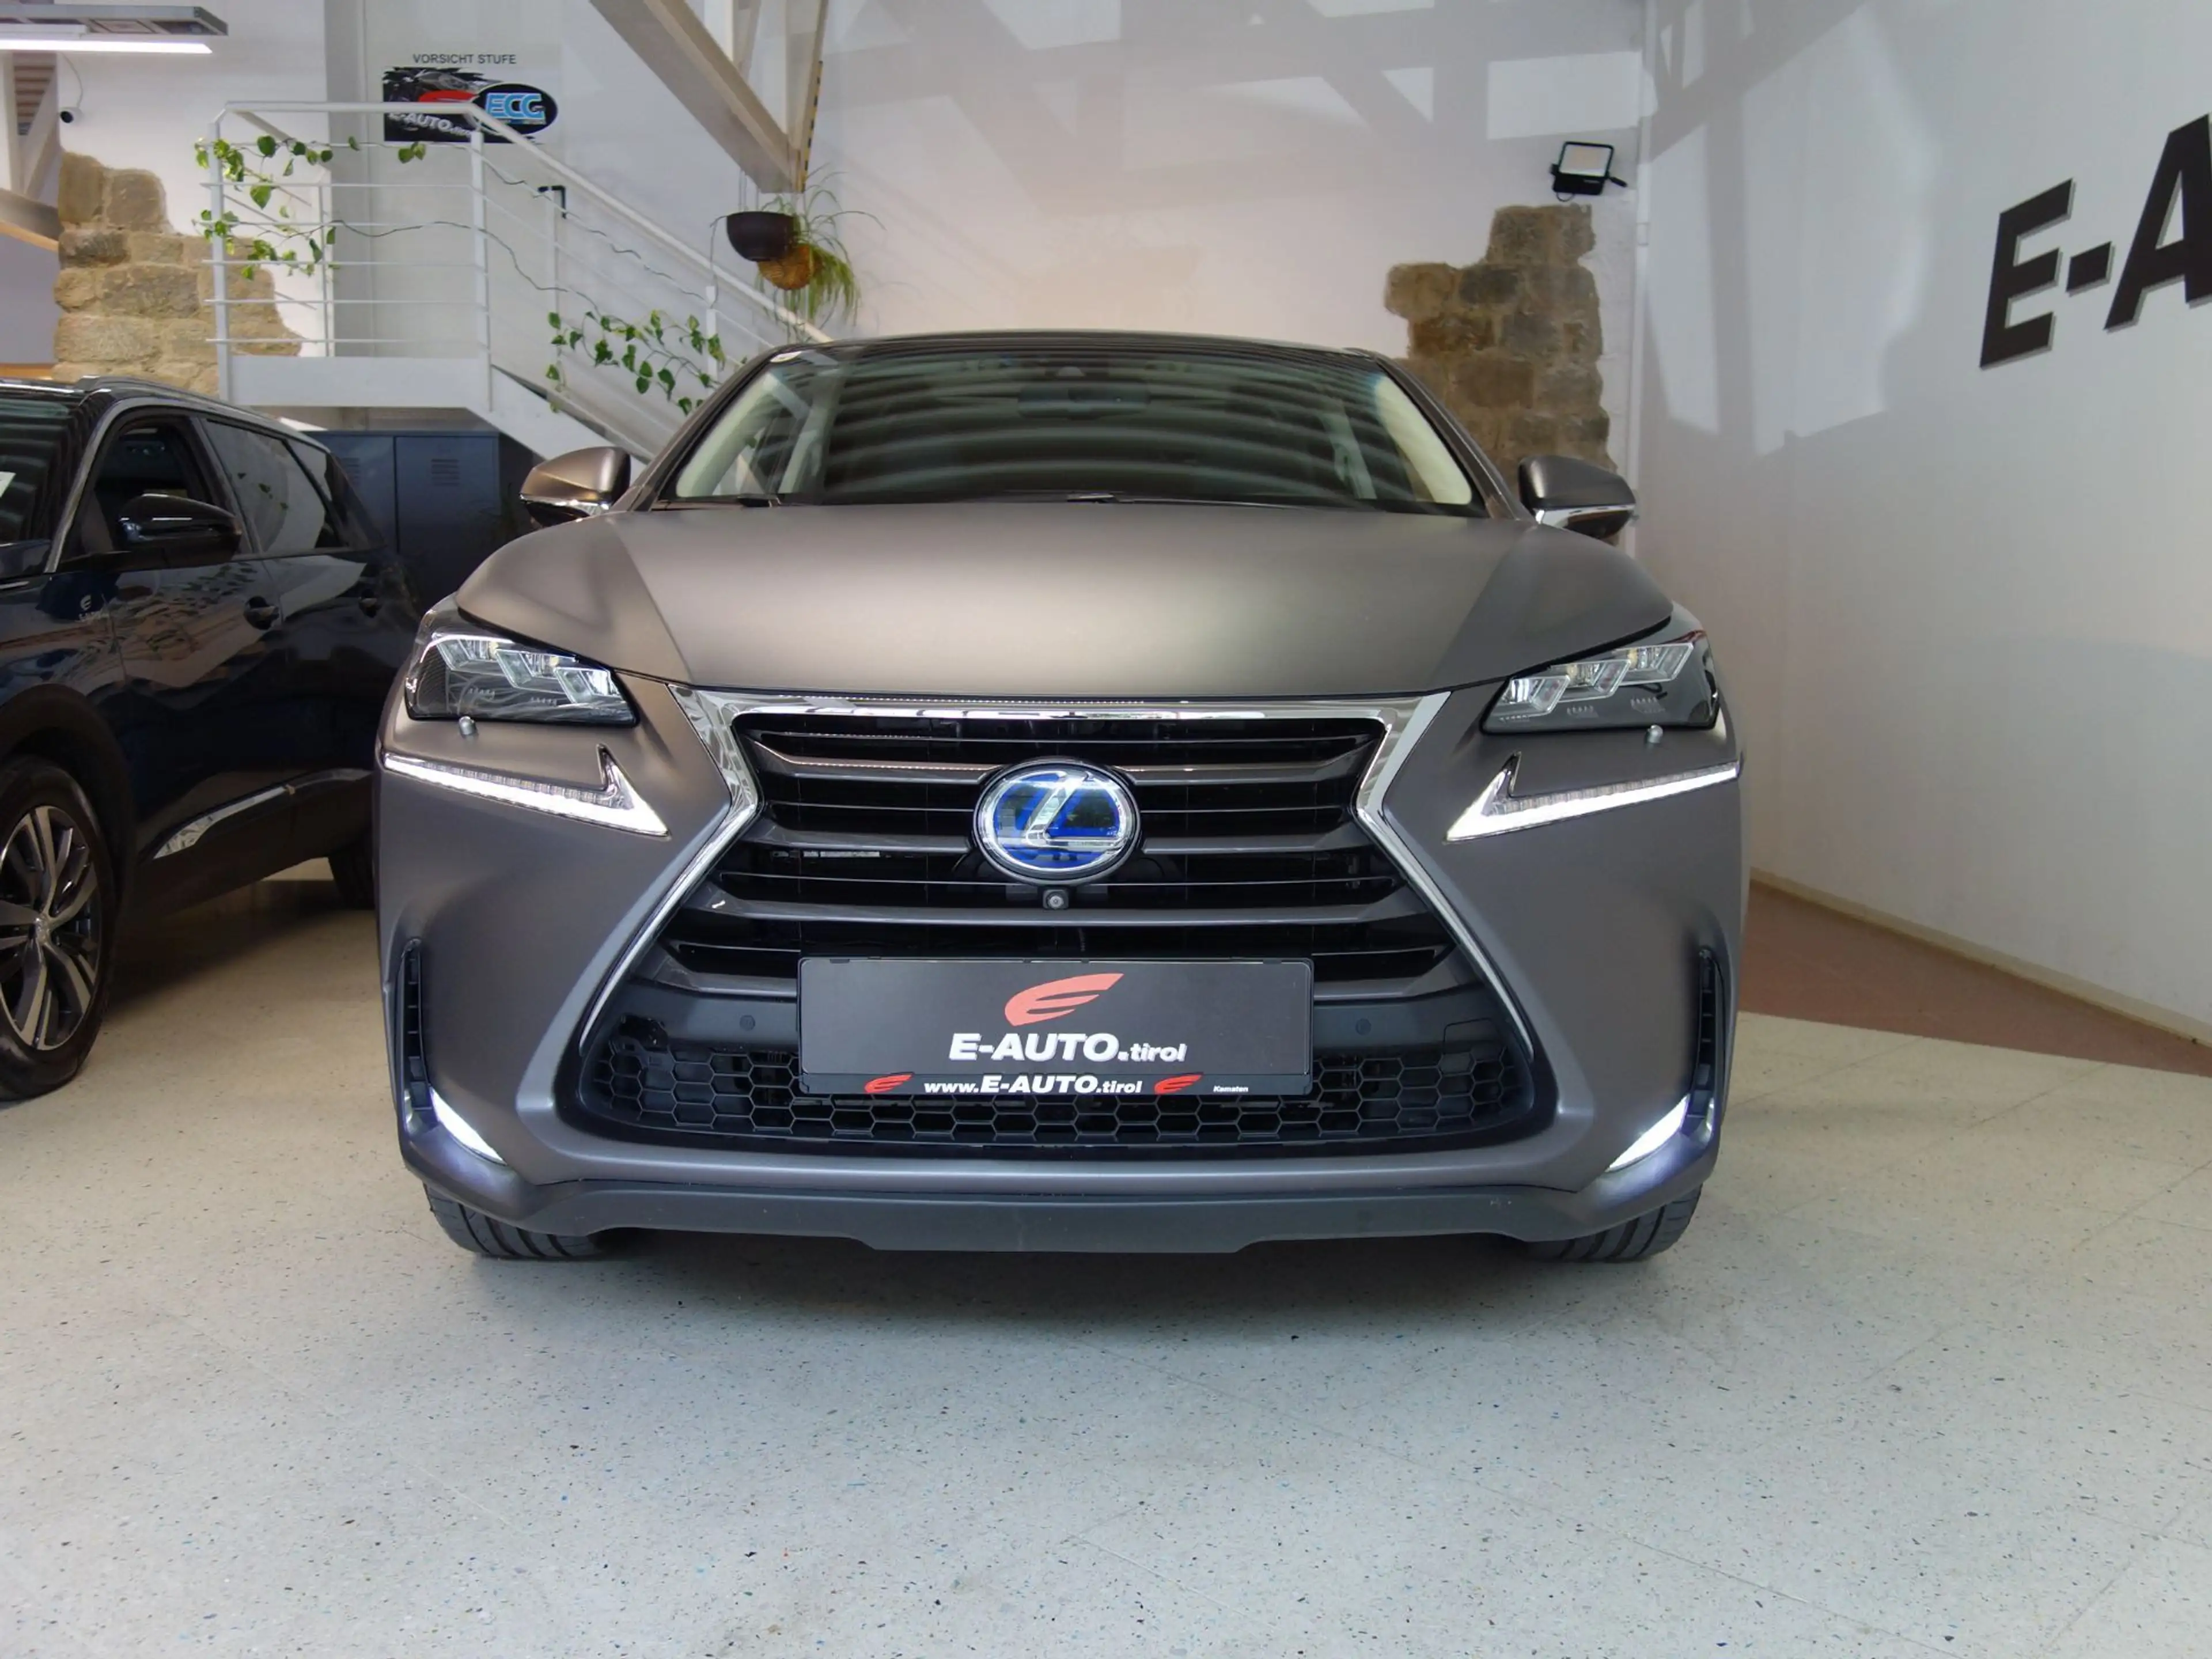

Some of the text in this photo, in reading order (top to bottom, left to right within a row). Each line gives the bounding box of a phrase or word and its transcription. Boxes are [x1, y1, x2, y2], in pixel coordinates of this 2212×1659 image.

[412, 54, 517, 64] VORSICHT STUFE
[949, 1033, 1187, 1062] E-AUTO.tirol
[923, 1075, 1142, 1094] www.E-AUTO.tirol
